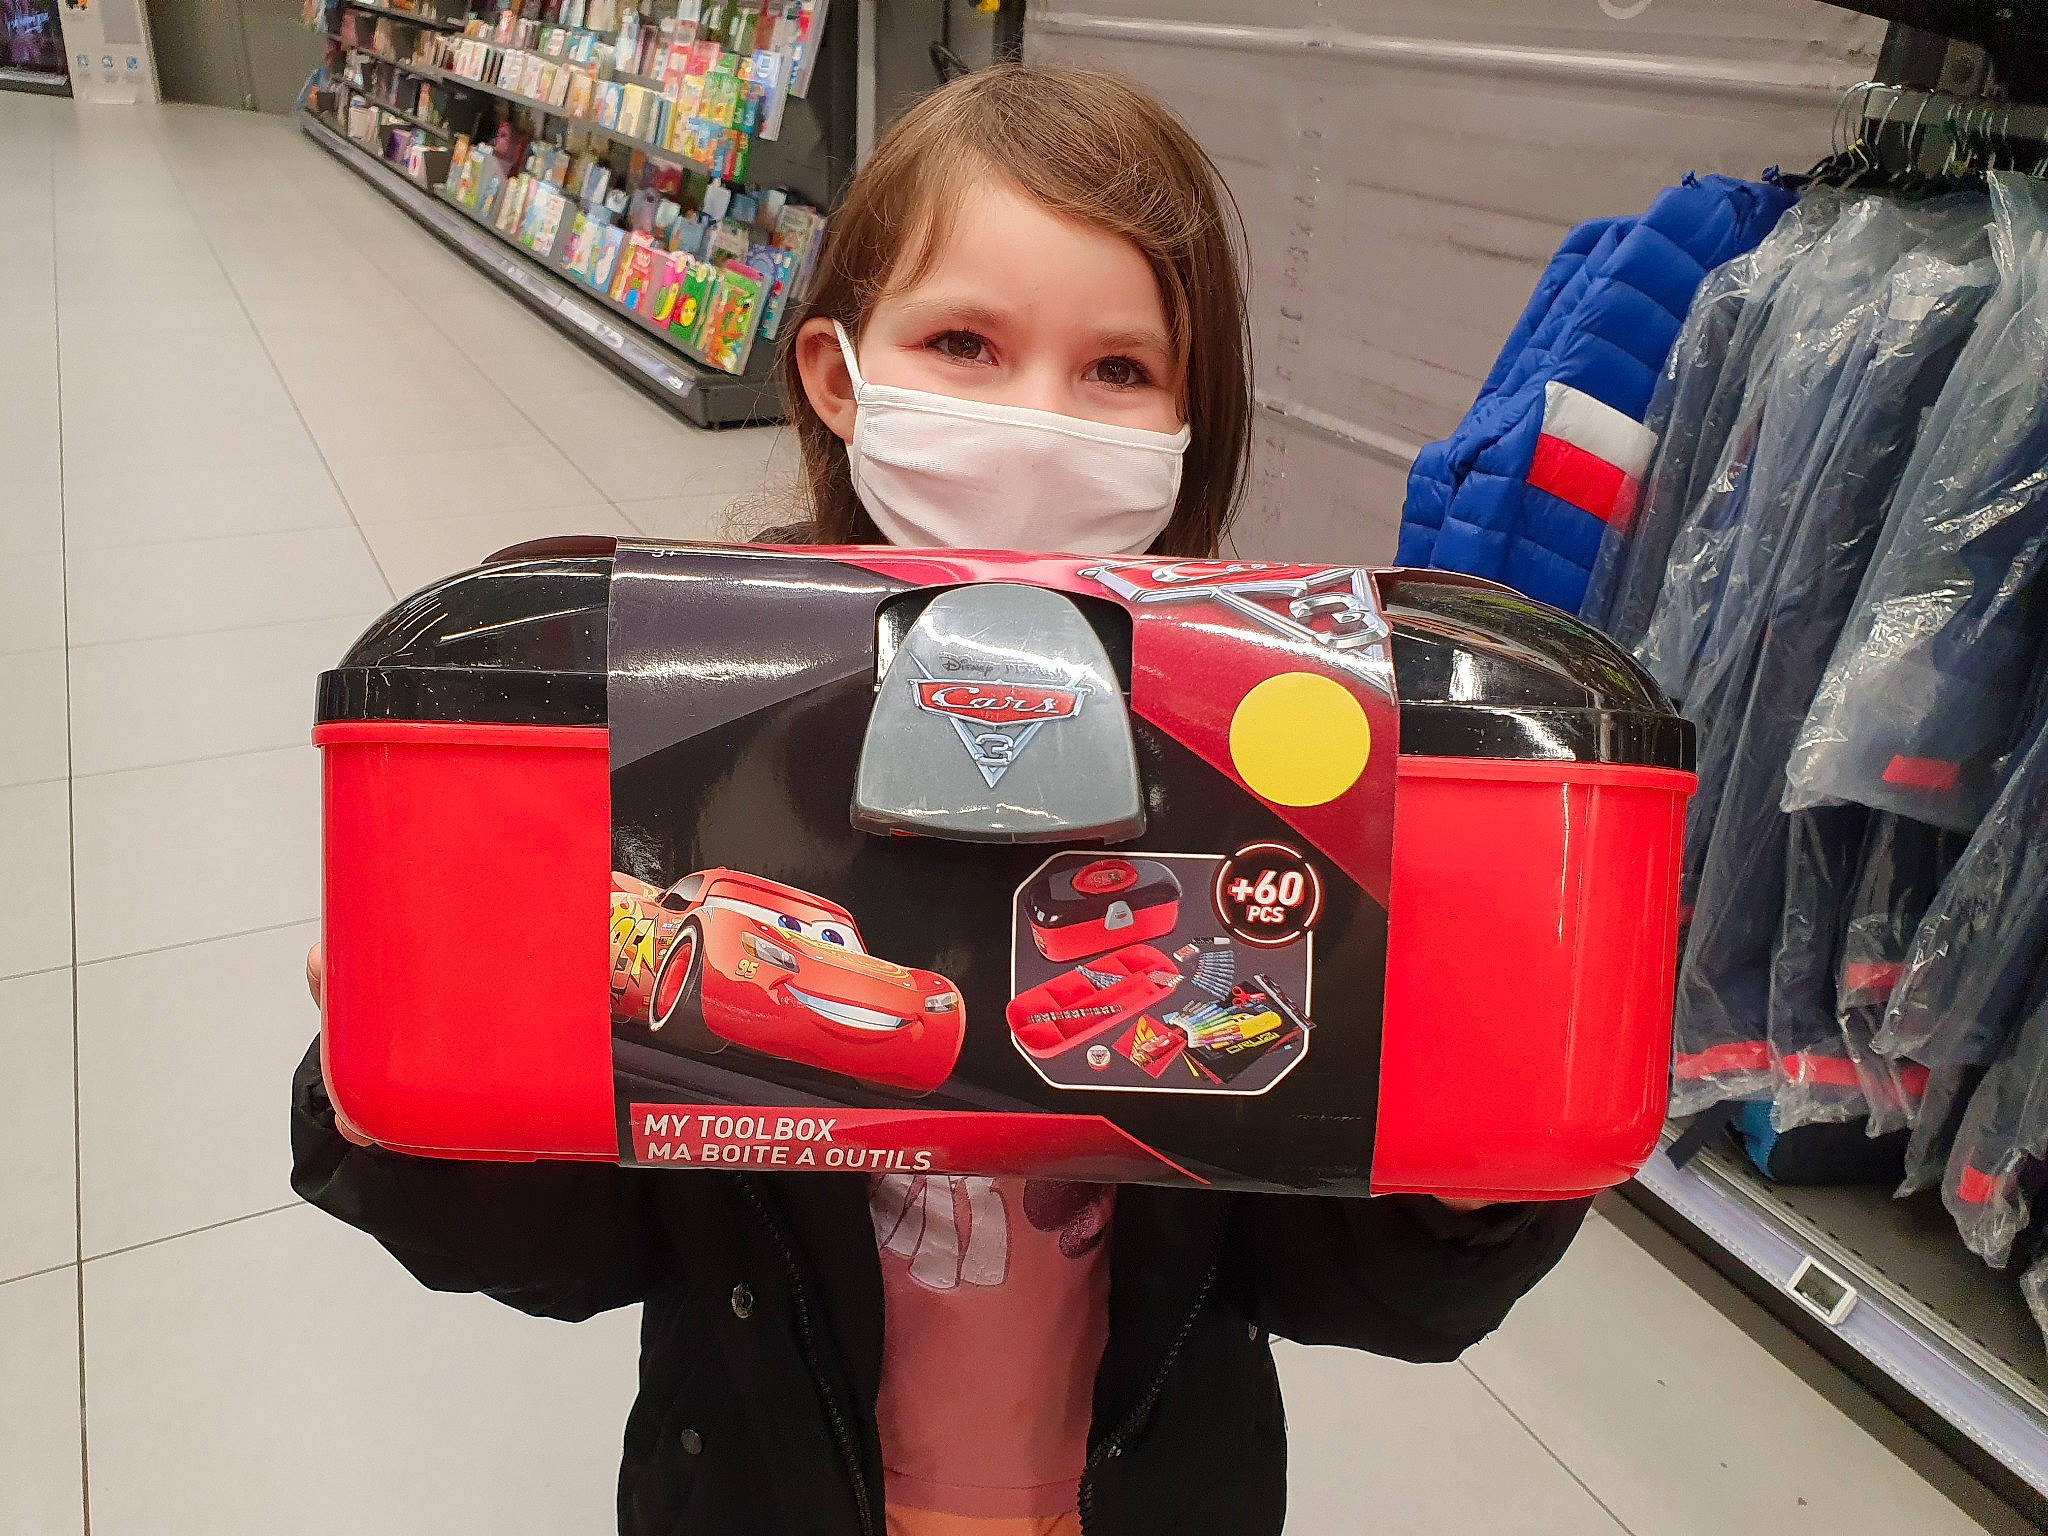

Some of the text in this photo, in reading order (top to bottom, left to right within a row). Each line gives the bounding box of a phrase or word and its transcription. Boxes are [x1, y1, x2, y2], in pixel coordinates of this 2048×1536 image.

[932, 687, 1059, 713] Cars
[976, 733, 1014, 766] 3
[1230, 871, 1304, 906] +60
[1247, 906, 1285, 922] PCS
[736, 959, 760, 979] 95
[644, 1114, 837, 1142] MY TOOLBOX
[648, 1142, 932, 1171] MA BOITE A OUTILS
